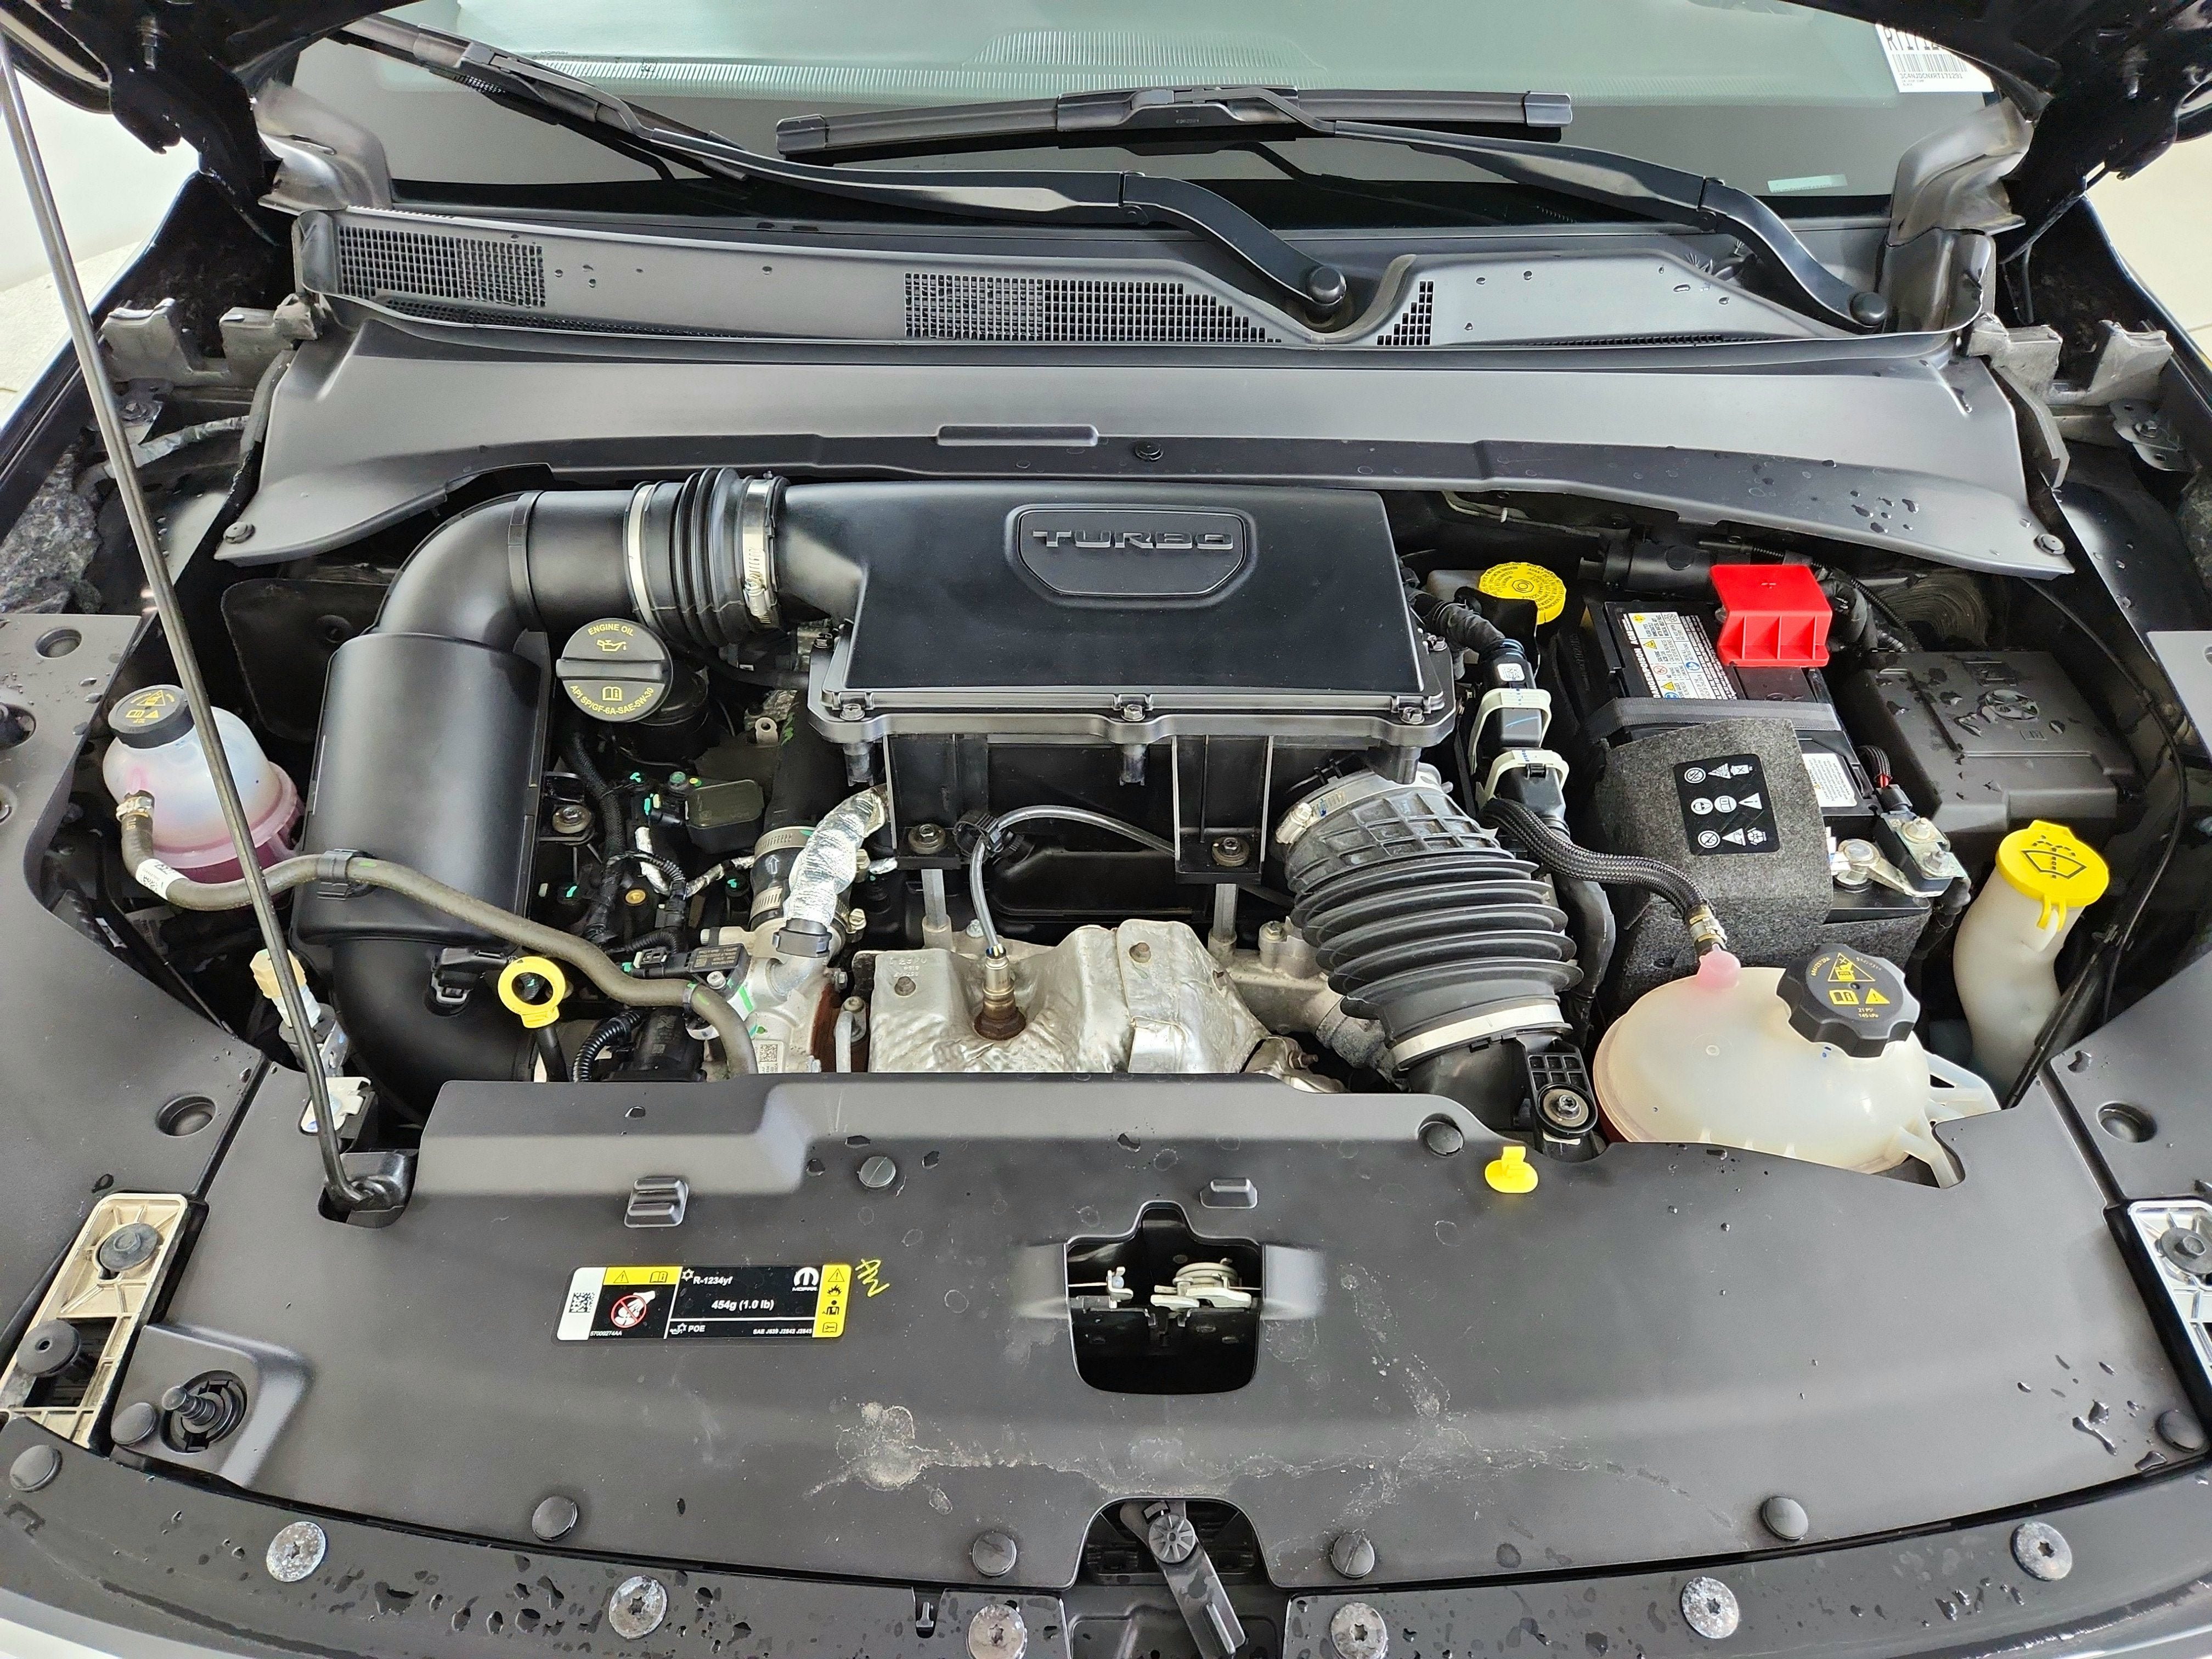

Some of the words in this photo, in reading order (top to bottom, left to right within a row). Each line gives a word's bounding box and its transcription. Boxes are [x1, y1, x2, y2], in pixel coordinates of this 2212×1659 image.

[1032, 529, 1234, 550] TURBO
[588, 623, 619, 636] ENGINE
[621, 626, 634, 636] OIL
[1626, 630, 1639, 644] AGM
[1633, 648, 1661, 698] DANGER/POISON
[570, 685, 583, 699] API
[580, 687, 654, 715] SP/GF-6A-SAE-5W-30
[693, 1276, 733, 1286] R-1234yf
[711, 1300, 737, 1311] 454g
[739, 1300, 759, 1311] (1.0
[760, 1299, 775, 1311] lb)
